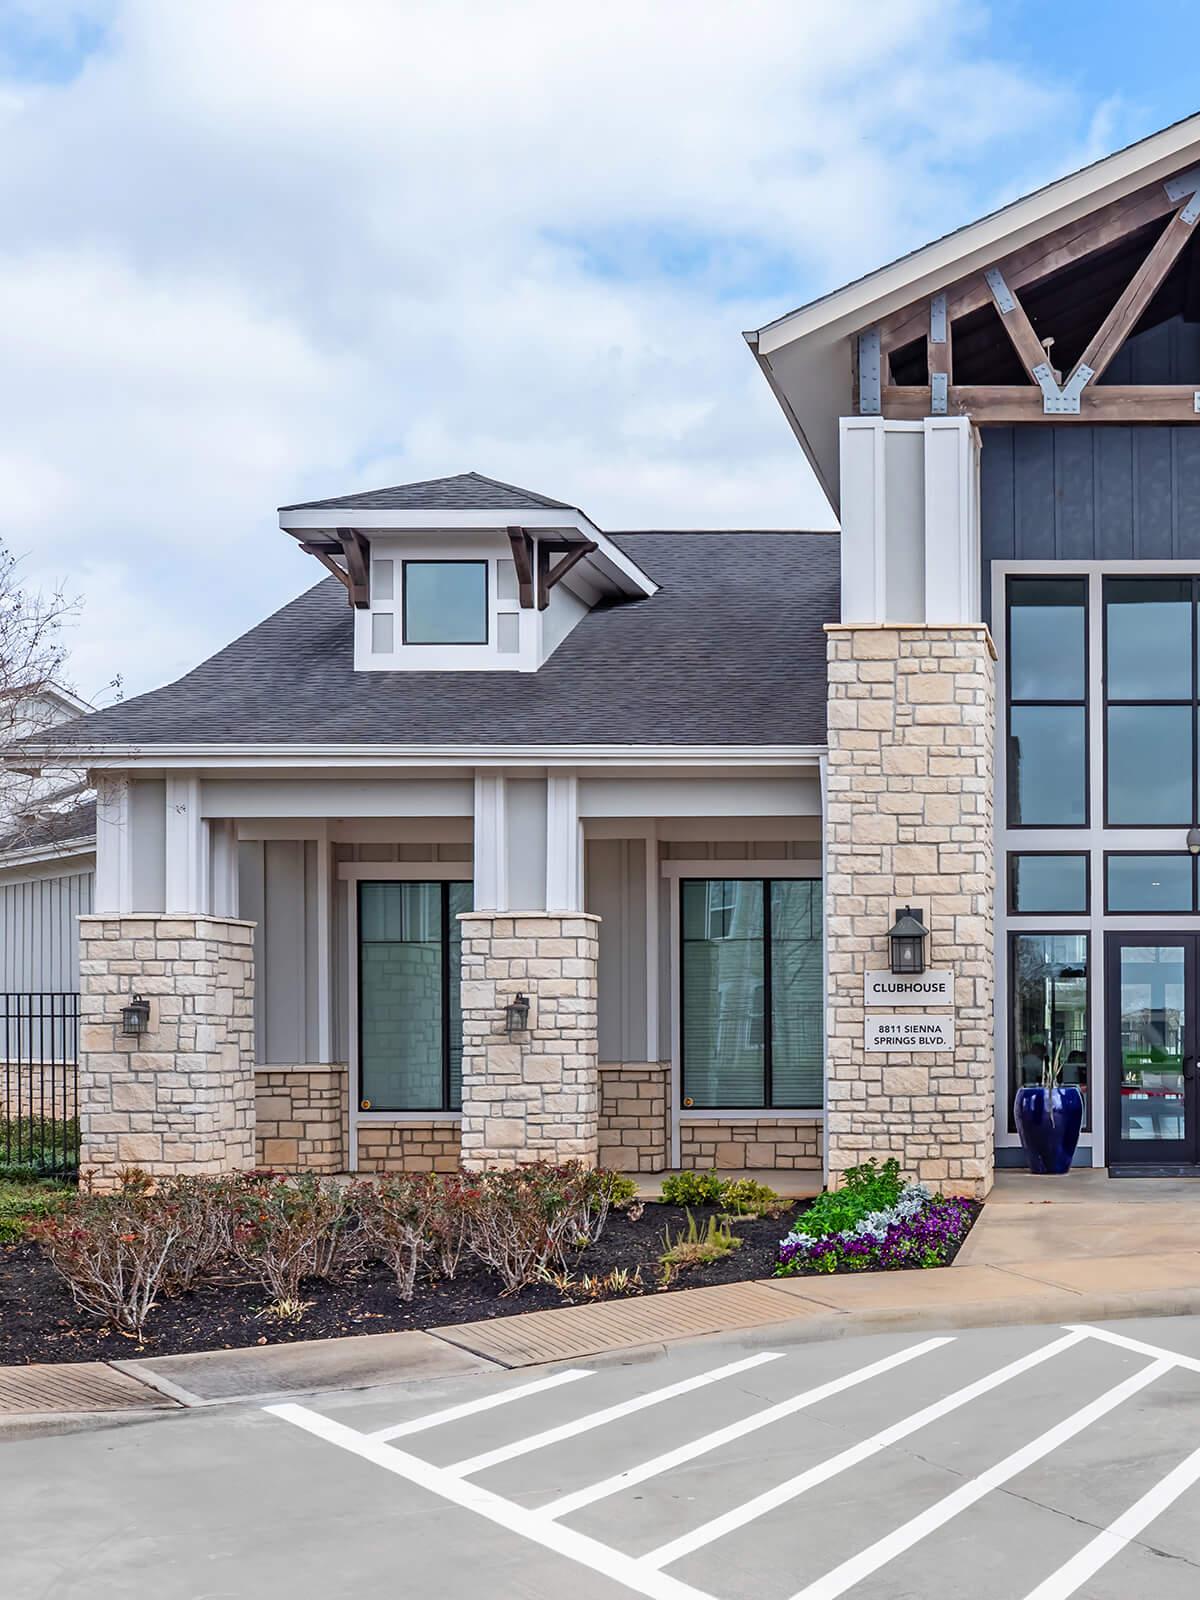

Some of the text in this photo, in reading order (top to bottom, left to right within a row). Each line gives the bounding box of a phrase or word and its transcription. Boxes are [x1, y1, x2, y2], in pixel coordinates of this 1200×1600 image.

[873, 983, 946, 993] CLUBHOUSE
[878, 1025, 942, 1033] 8811 SIENNA
[874, 1036, 946, 1045] SPRINGS BLVD.
